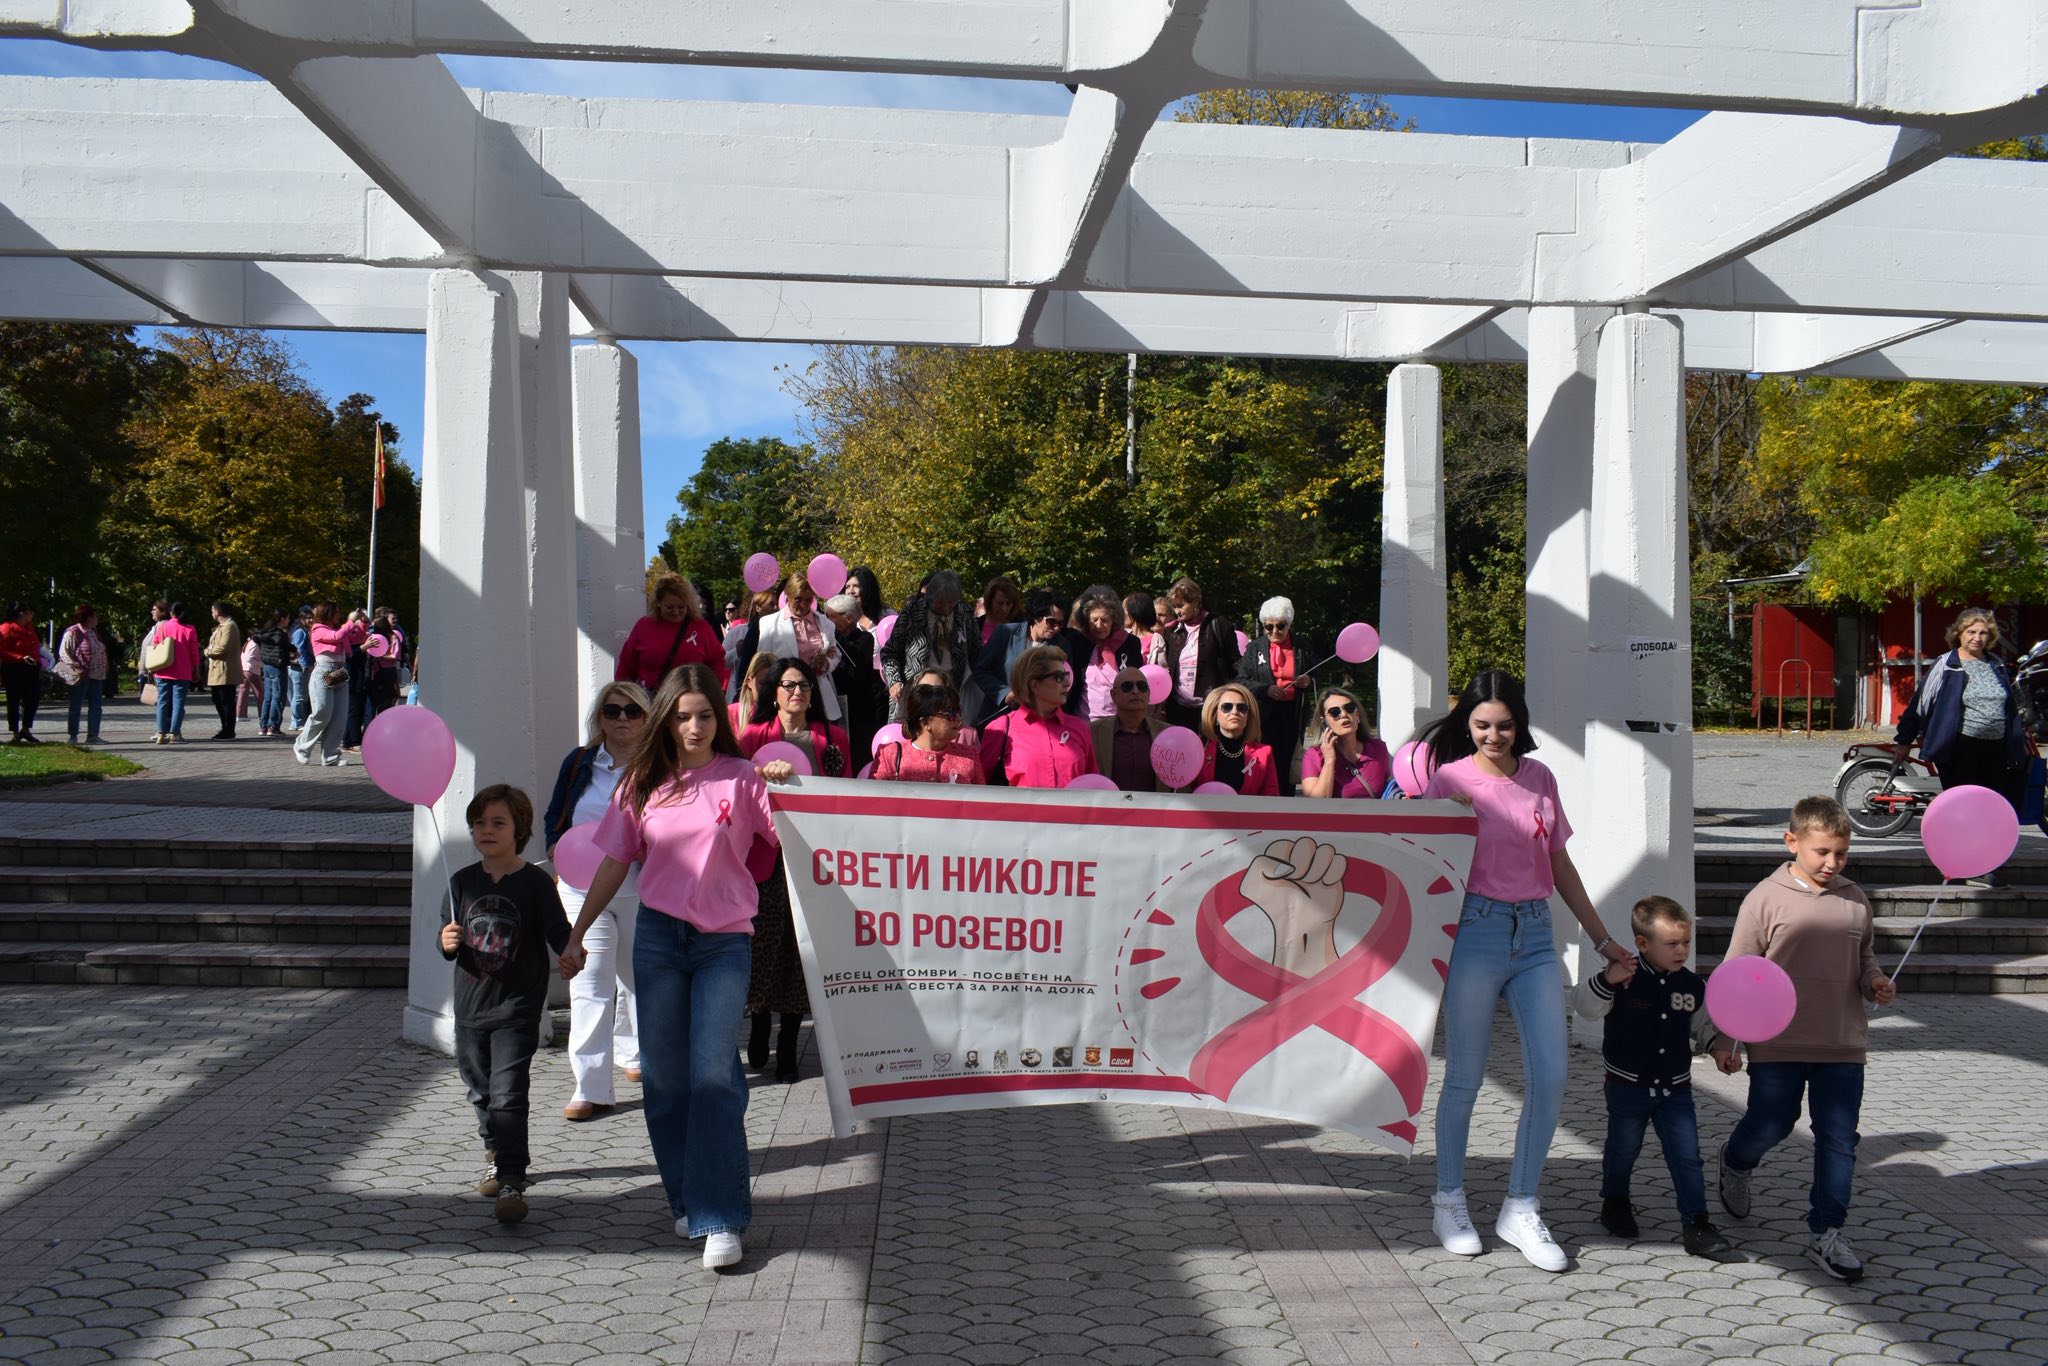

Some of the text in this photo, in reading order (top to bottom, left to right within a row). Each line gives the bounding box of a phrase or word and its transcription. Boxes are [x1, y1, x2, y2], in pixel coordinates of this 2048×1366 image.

[812, 849, 1098, 897] СВЕТИ НИКОЛЕ
[855, 910, 1063, 953] ВО РОЗЕВО!
[823, 970, 872, 983] МЕСЕЦ
[877, 969, 957, 978] ОКТОМВРИ
[973, 971, 1048, 981] ПОСВЕТЕН
[884, 983, 903, 991] НА
[908, 982, 964, 990] СВЕСТА
[970, 983, 986, 991] ЗА
[992, 984, 1019, 992] РАК
[1024, 985, 1043, 993] НА
[1047, 986, 1095, 995] ДОЈКА
[854, 1048, 901, 1059] поддржано
